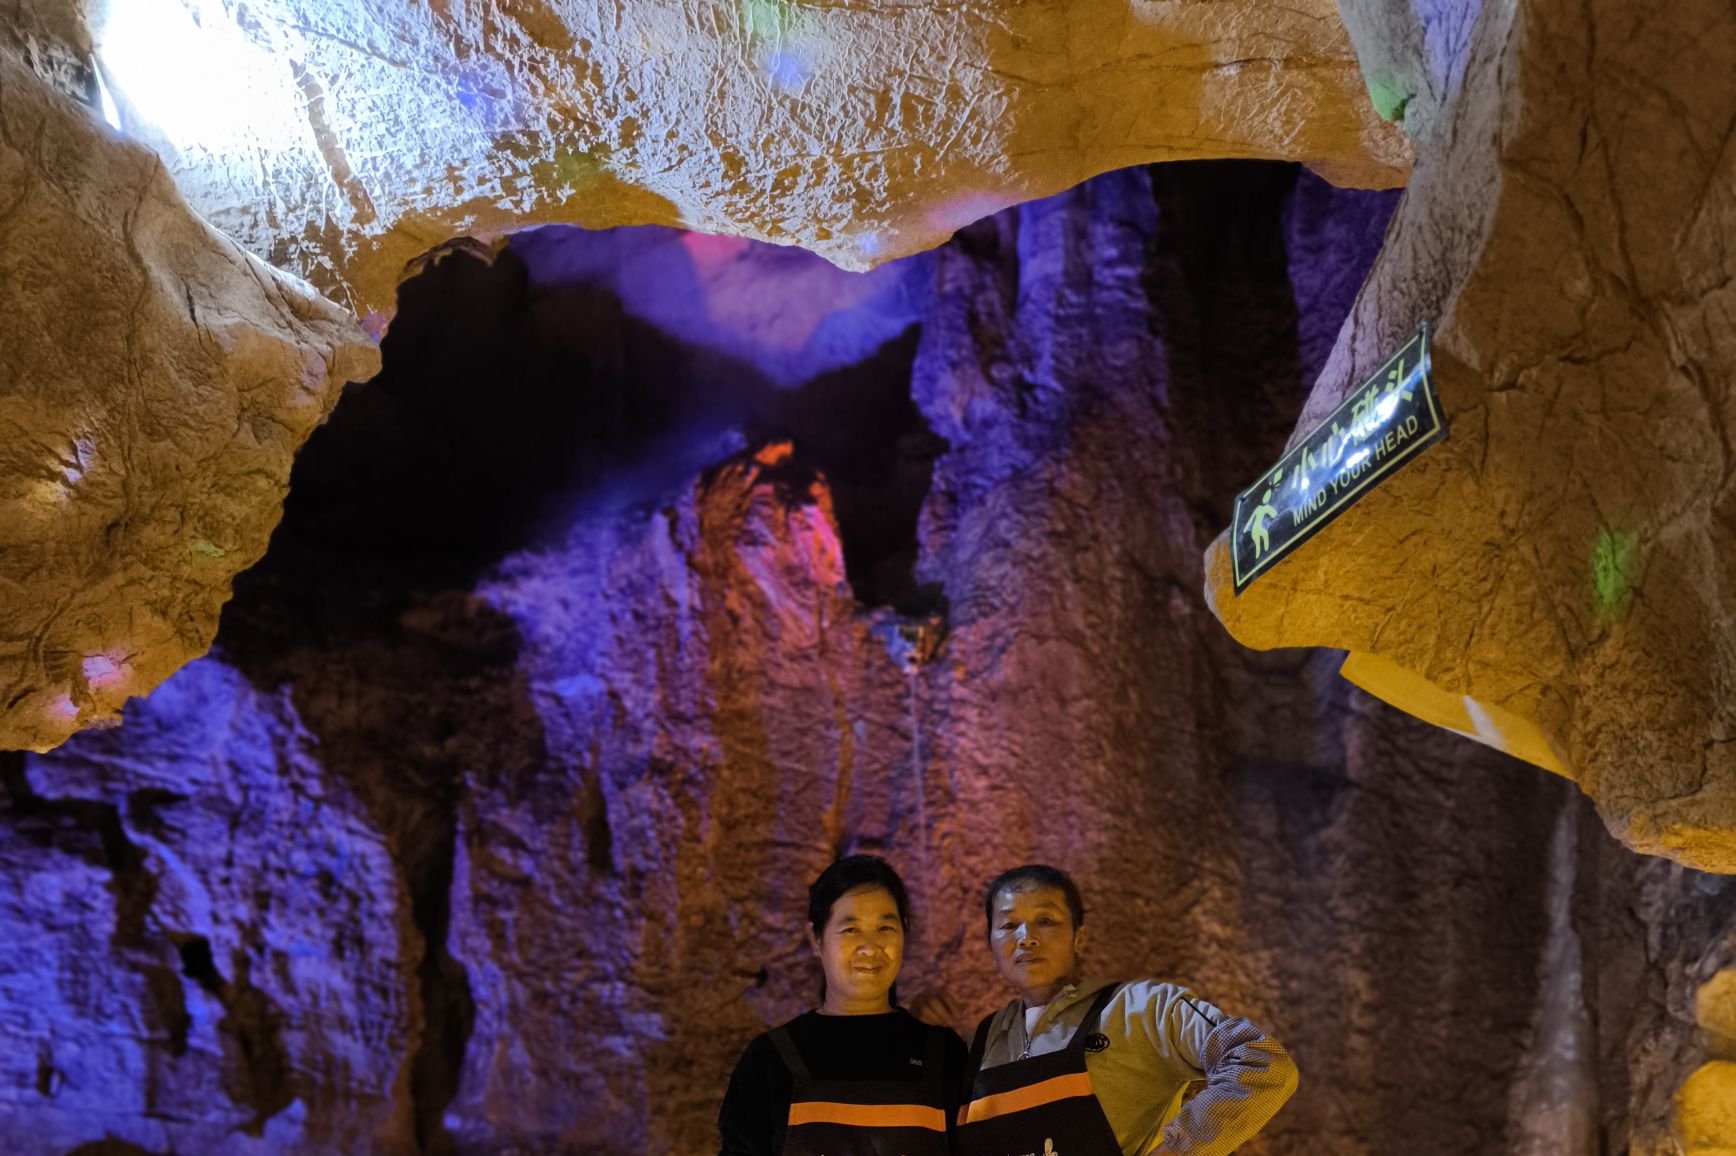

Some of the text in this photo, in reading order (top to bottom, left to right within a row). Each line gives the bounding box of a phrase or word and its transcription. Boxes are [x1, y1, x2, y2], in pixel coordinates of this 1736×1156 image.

[1292, 415, 1419, 527] MIND YOUR HEAD
